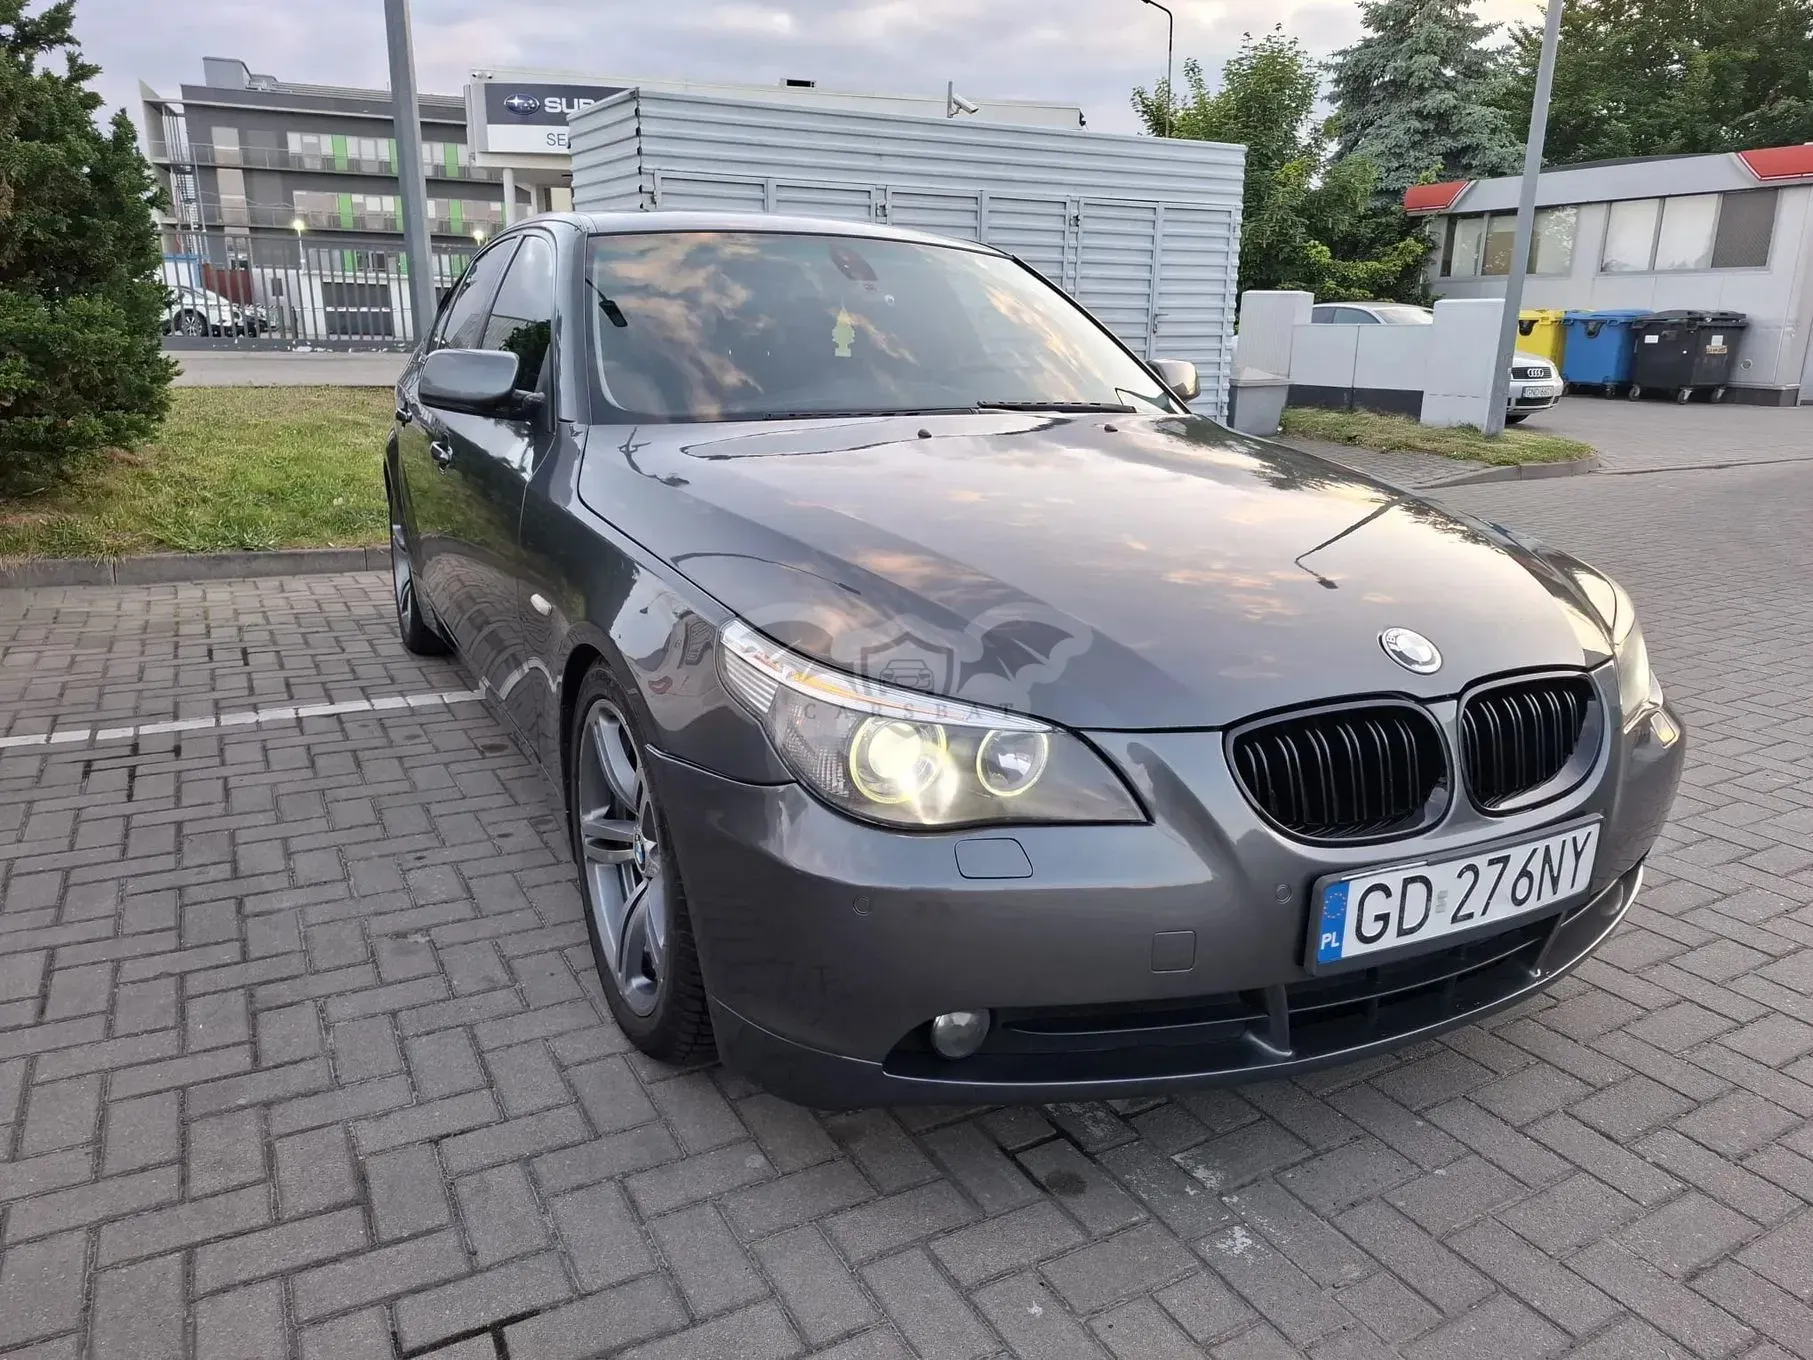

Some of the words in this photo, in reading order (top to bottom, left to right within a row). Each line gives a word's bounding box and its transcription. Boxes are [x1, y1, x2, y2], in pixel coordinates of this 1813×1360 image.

[1355, 874, 1433, 944] GD
[1450, 831, 1592, 925] 276NY
[1320, 932, 1340, 950] PL
